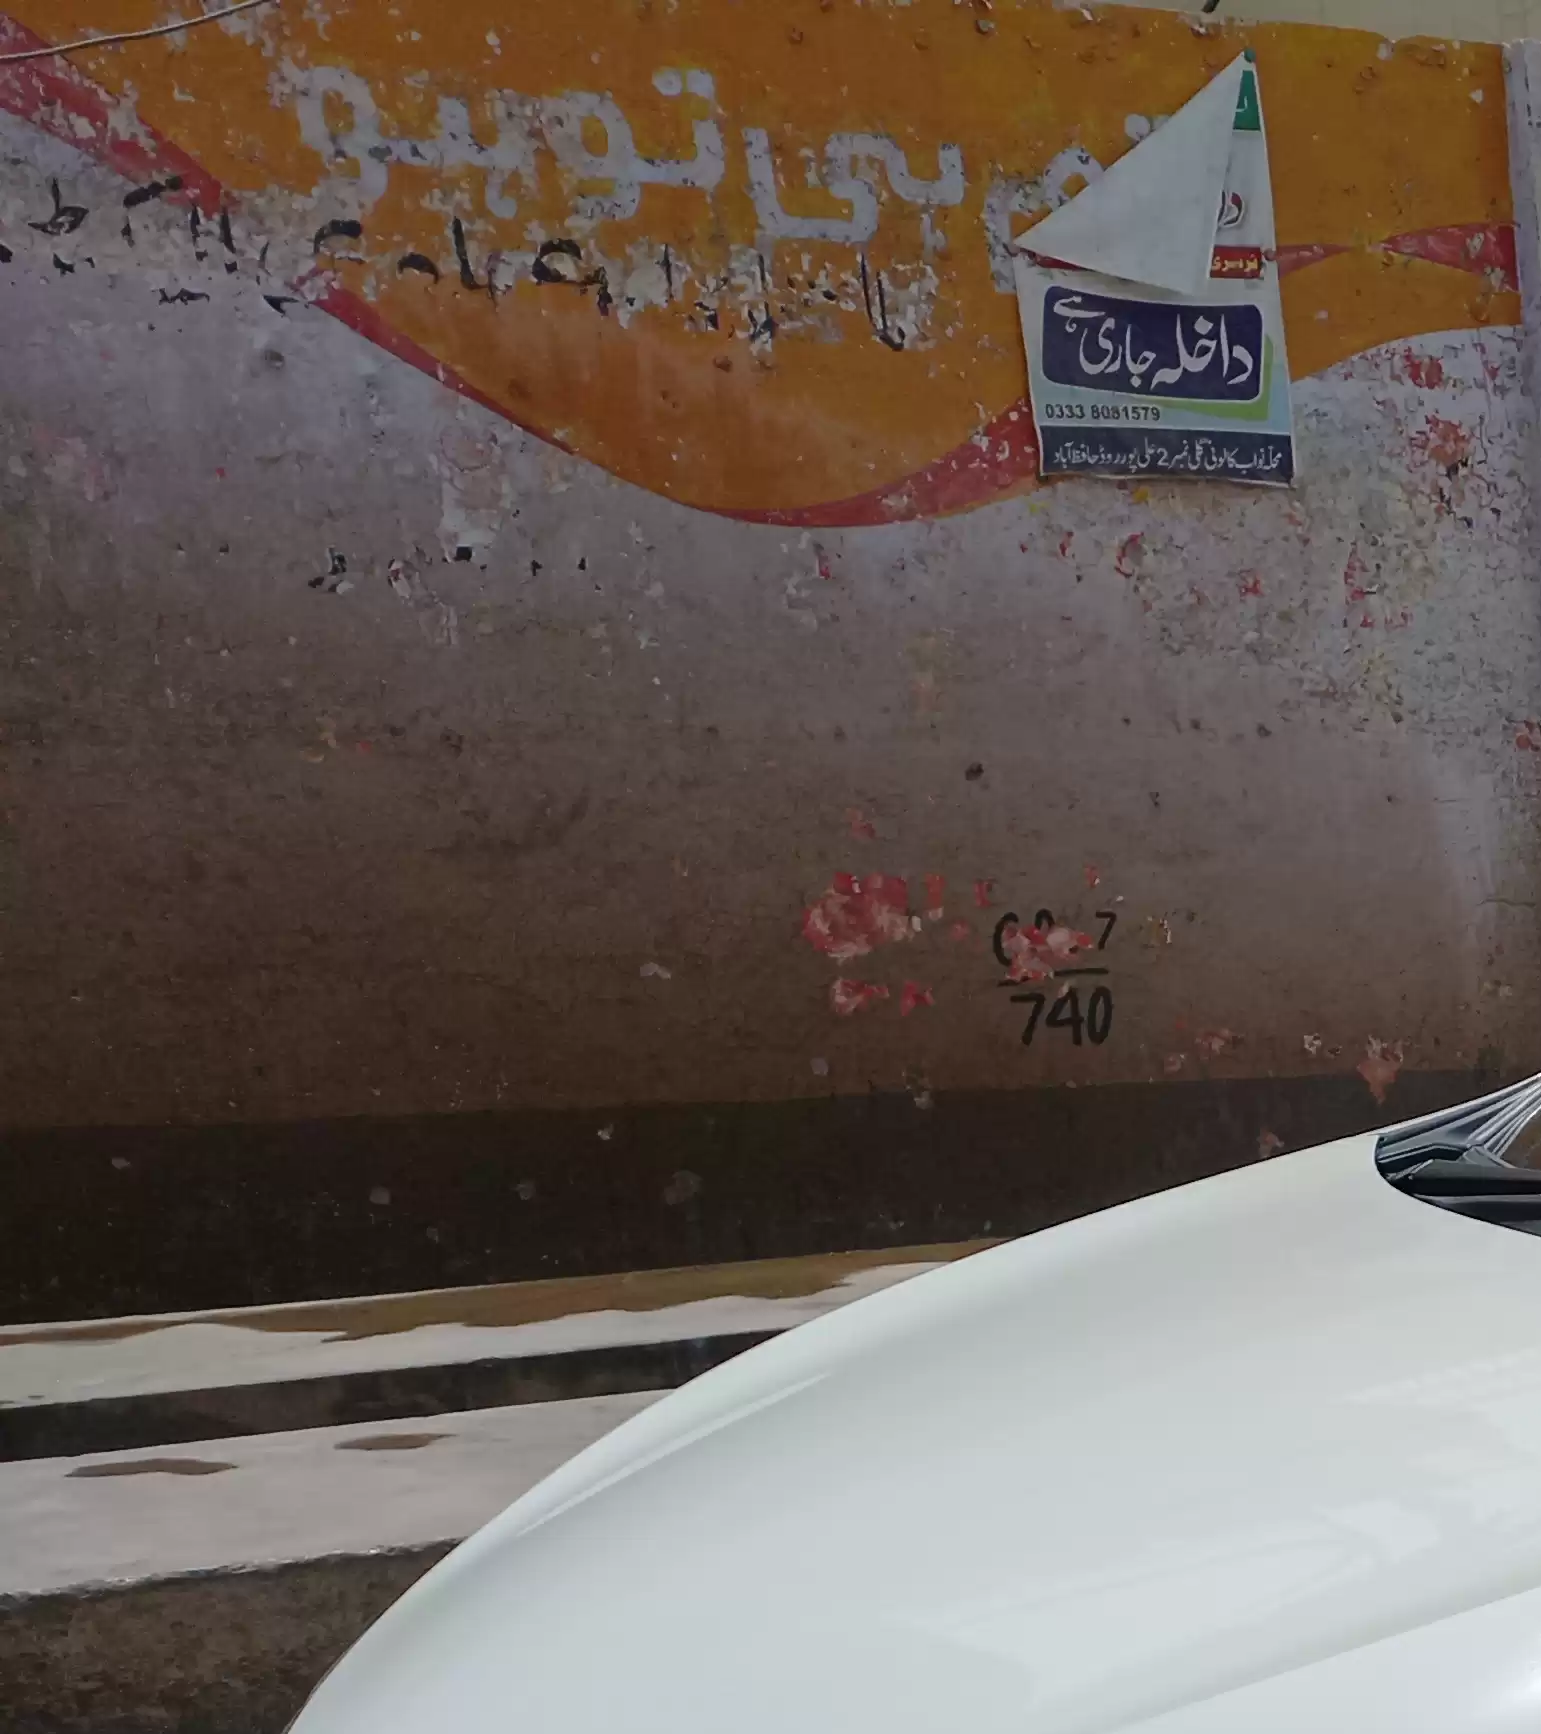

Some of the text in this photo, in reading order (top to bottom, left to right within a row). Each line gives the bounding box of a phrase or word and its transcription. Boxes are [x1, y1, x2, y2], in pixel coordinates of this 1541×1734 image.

[1053, 295, 1254, 391] داخلہ جاری ہے
[1045, 404, 1086, 420] 0333
[1157, 447, 1169, 466] 2
[1010, 986, 1113, 1046] 740
